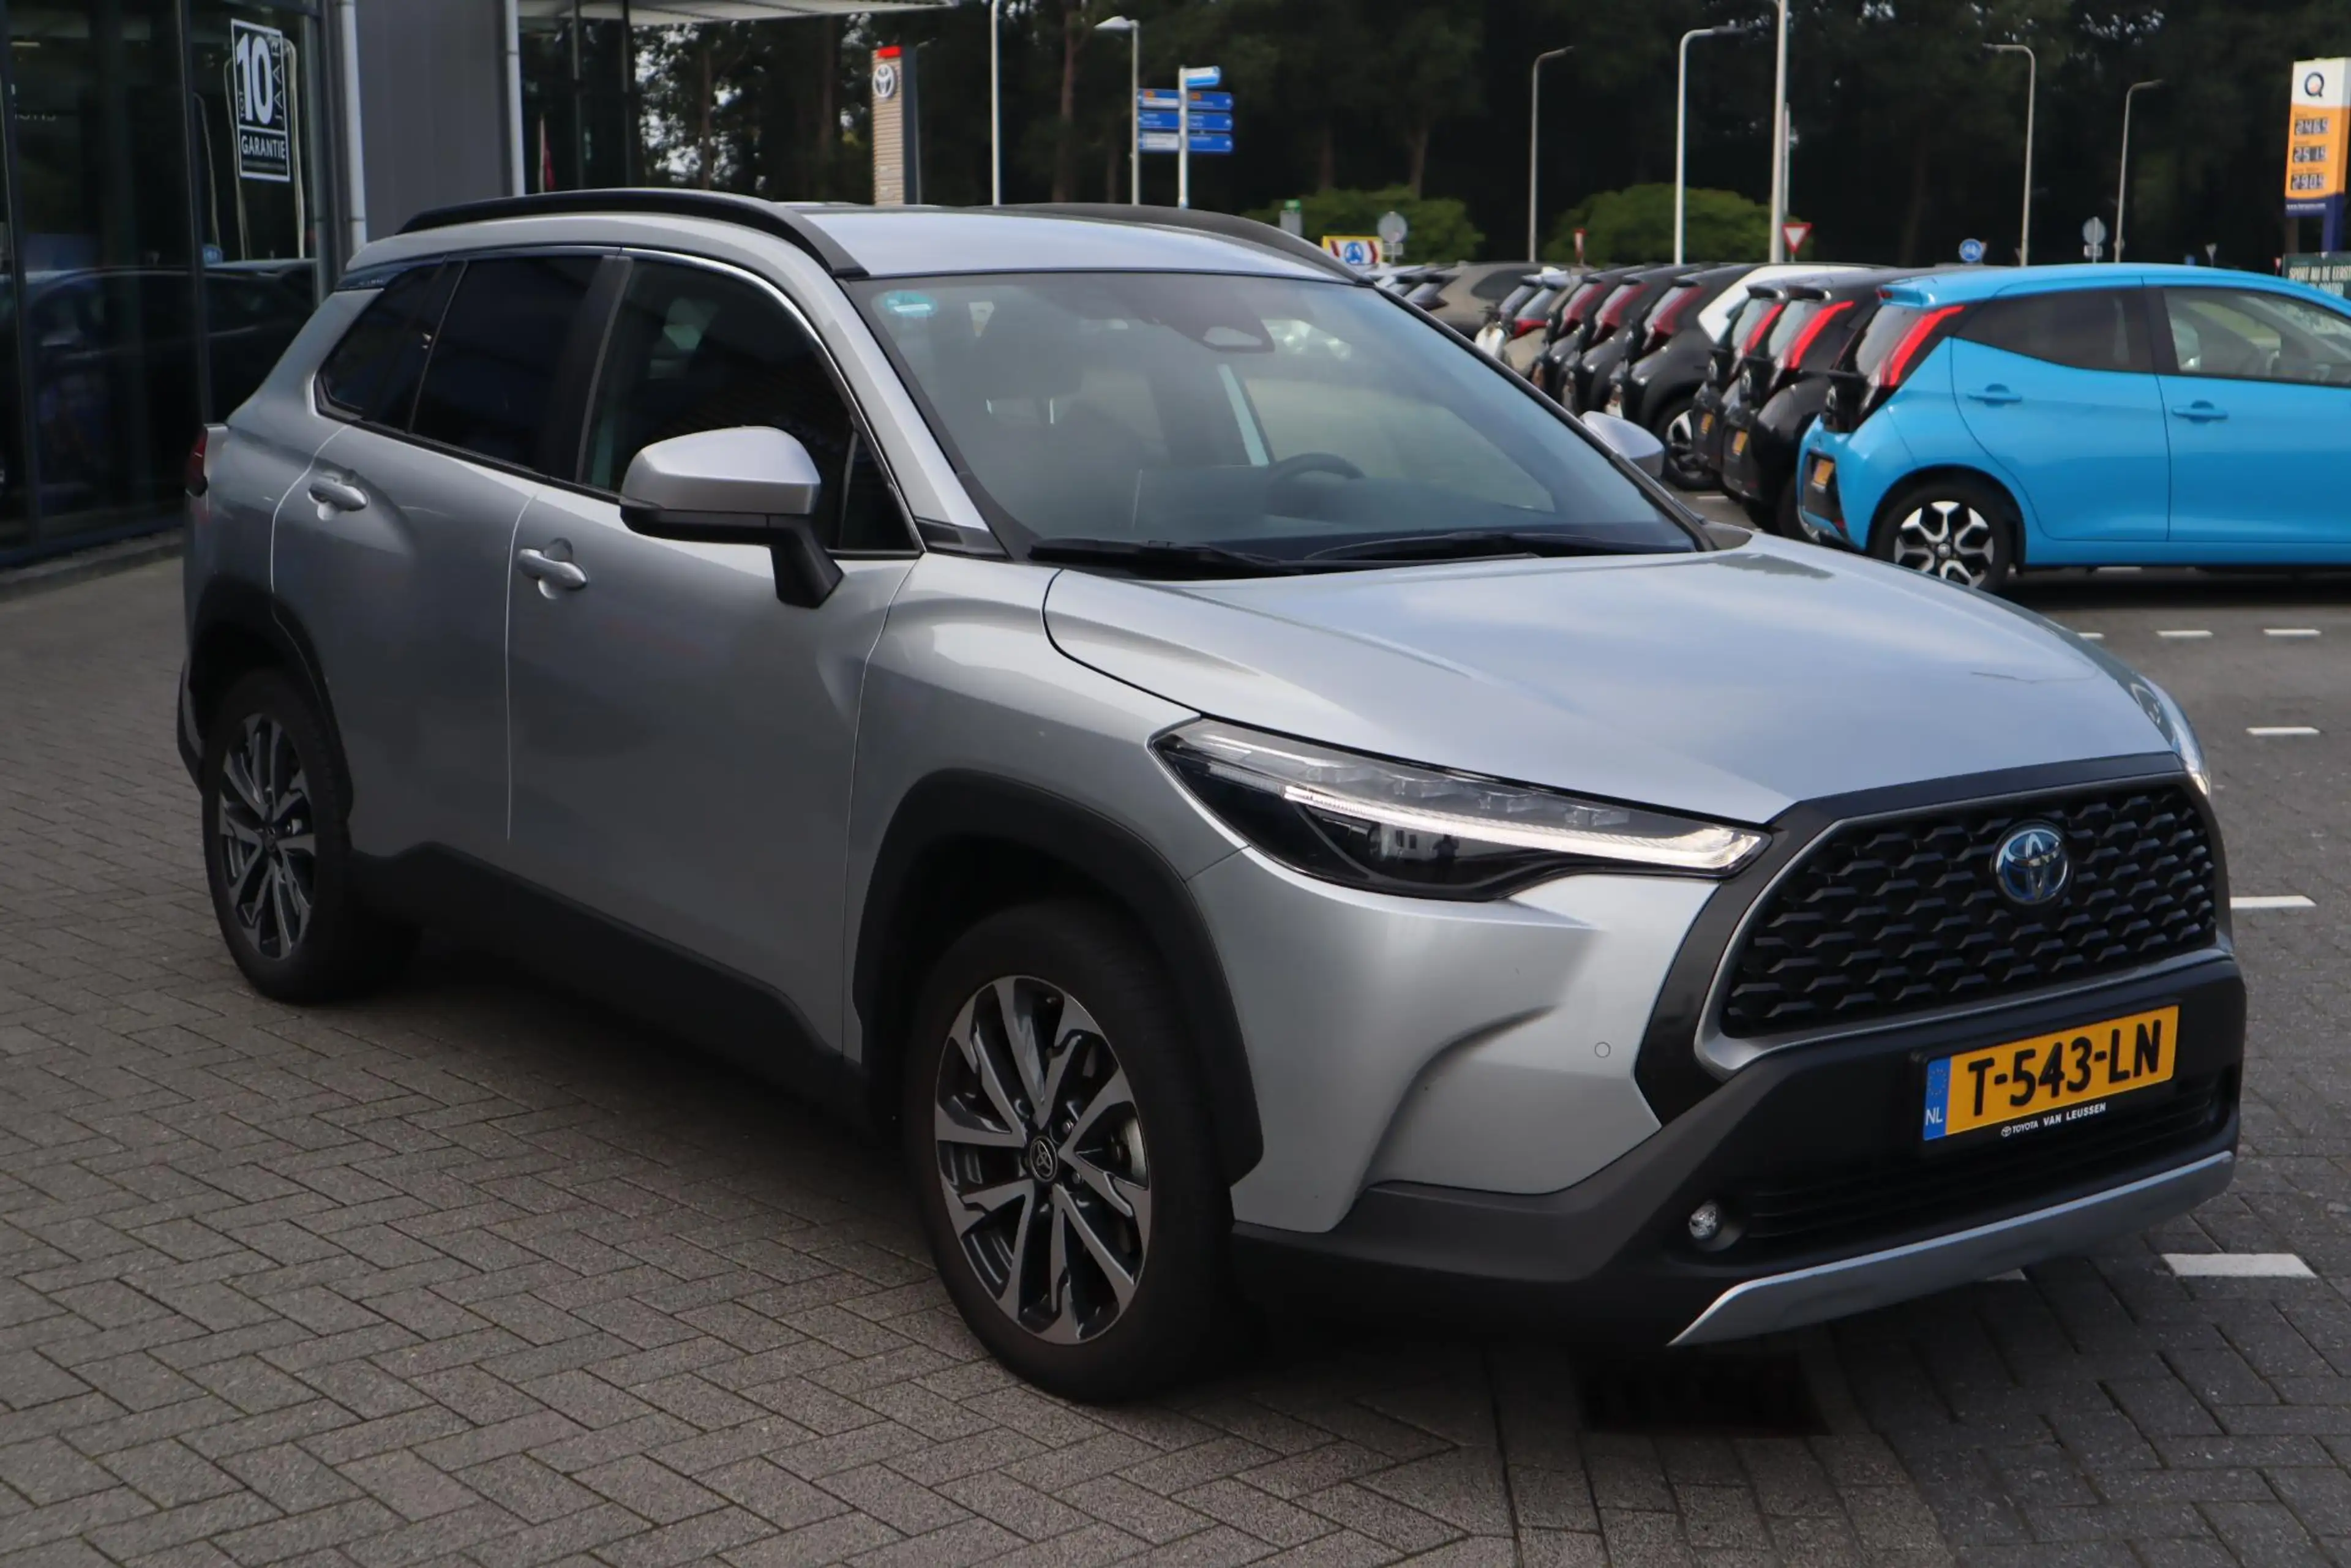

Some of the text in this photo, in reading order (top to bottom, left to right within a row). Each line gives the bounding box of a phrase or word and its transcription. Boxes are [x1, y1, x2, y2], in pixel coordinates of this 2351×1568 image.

[236, 32, 273, 124] 10
[241, 135, 286, 160] GARANTIE
[1968, 1019, 2161, 1117] T-543-LN
[1925, 1107, 1943, 1126] NL
[2012, 1102, 2106, 1133] TOYOTA VAN LEUSSEN
